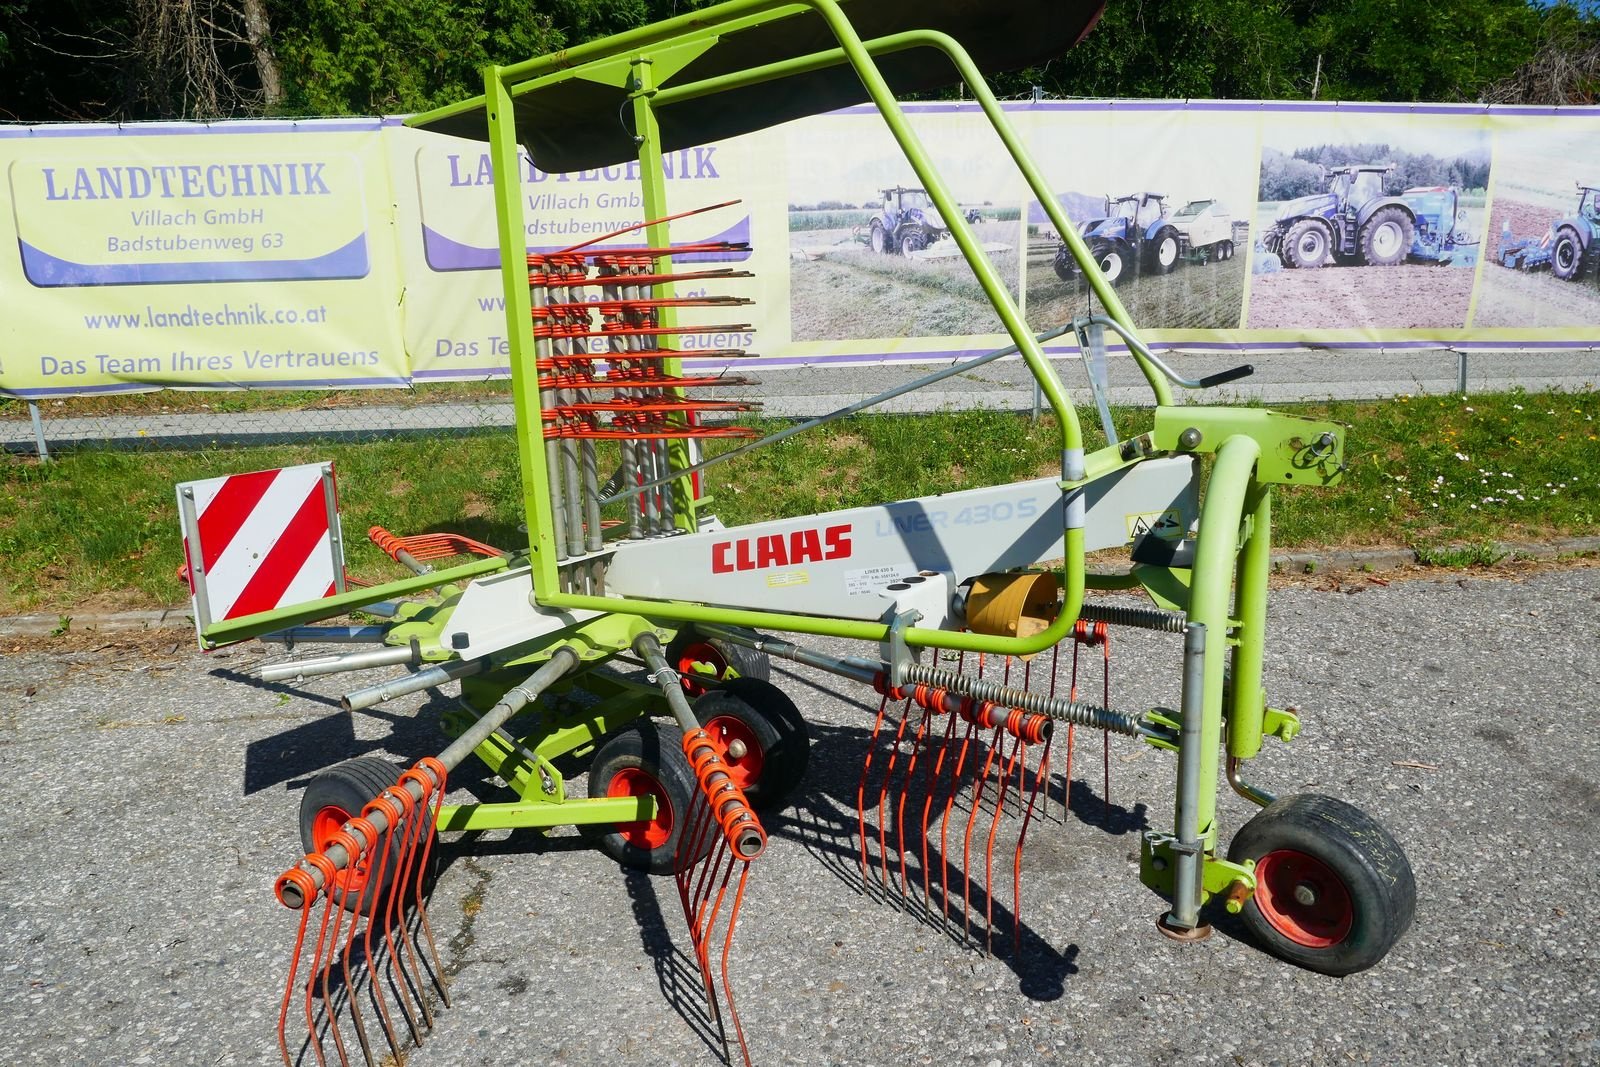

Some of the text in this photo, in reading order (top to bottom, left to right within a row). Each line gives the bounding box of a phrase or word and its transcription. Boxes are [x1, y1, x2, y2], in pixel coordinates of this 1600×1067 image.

[41, 162, 331, 201] LANDTECHNIK
[528, 191, 644, 210] Villach Gmb
[131, 208, 264, 227] Villach GmbH
[523, 217, 643, 236] dstubenweg
[107, 233, 284, 253] Badstubenweg 63
[84, 303, 327, 329] www.landtechnik.co.at
[436, 338, 479, 357] Das
[41, 349, 380, 376] Das Team Ihres Vertrauens
[875, 497, 1038, 537] LINER 430 S
[711, 524, 852, 574] CLAAS
